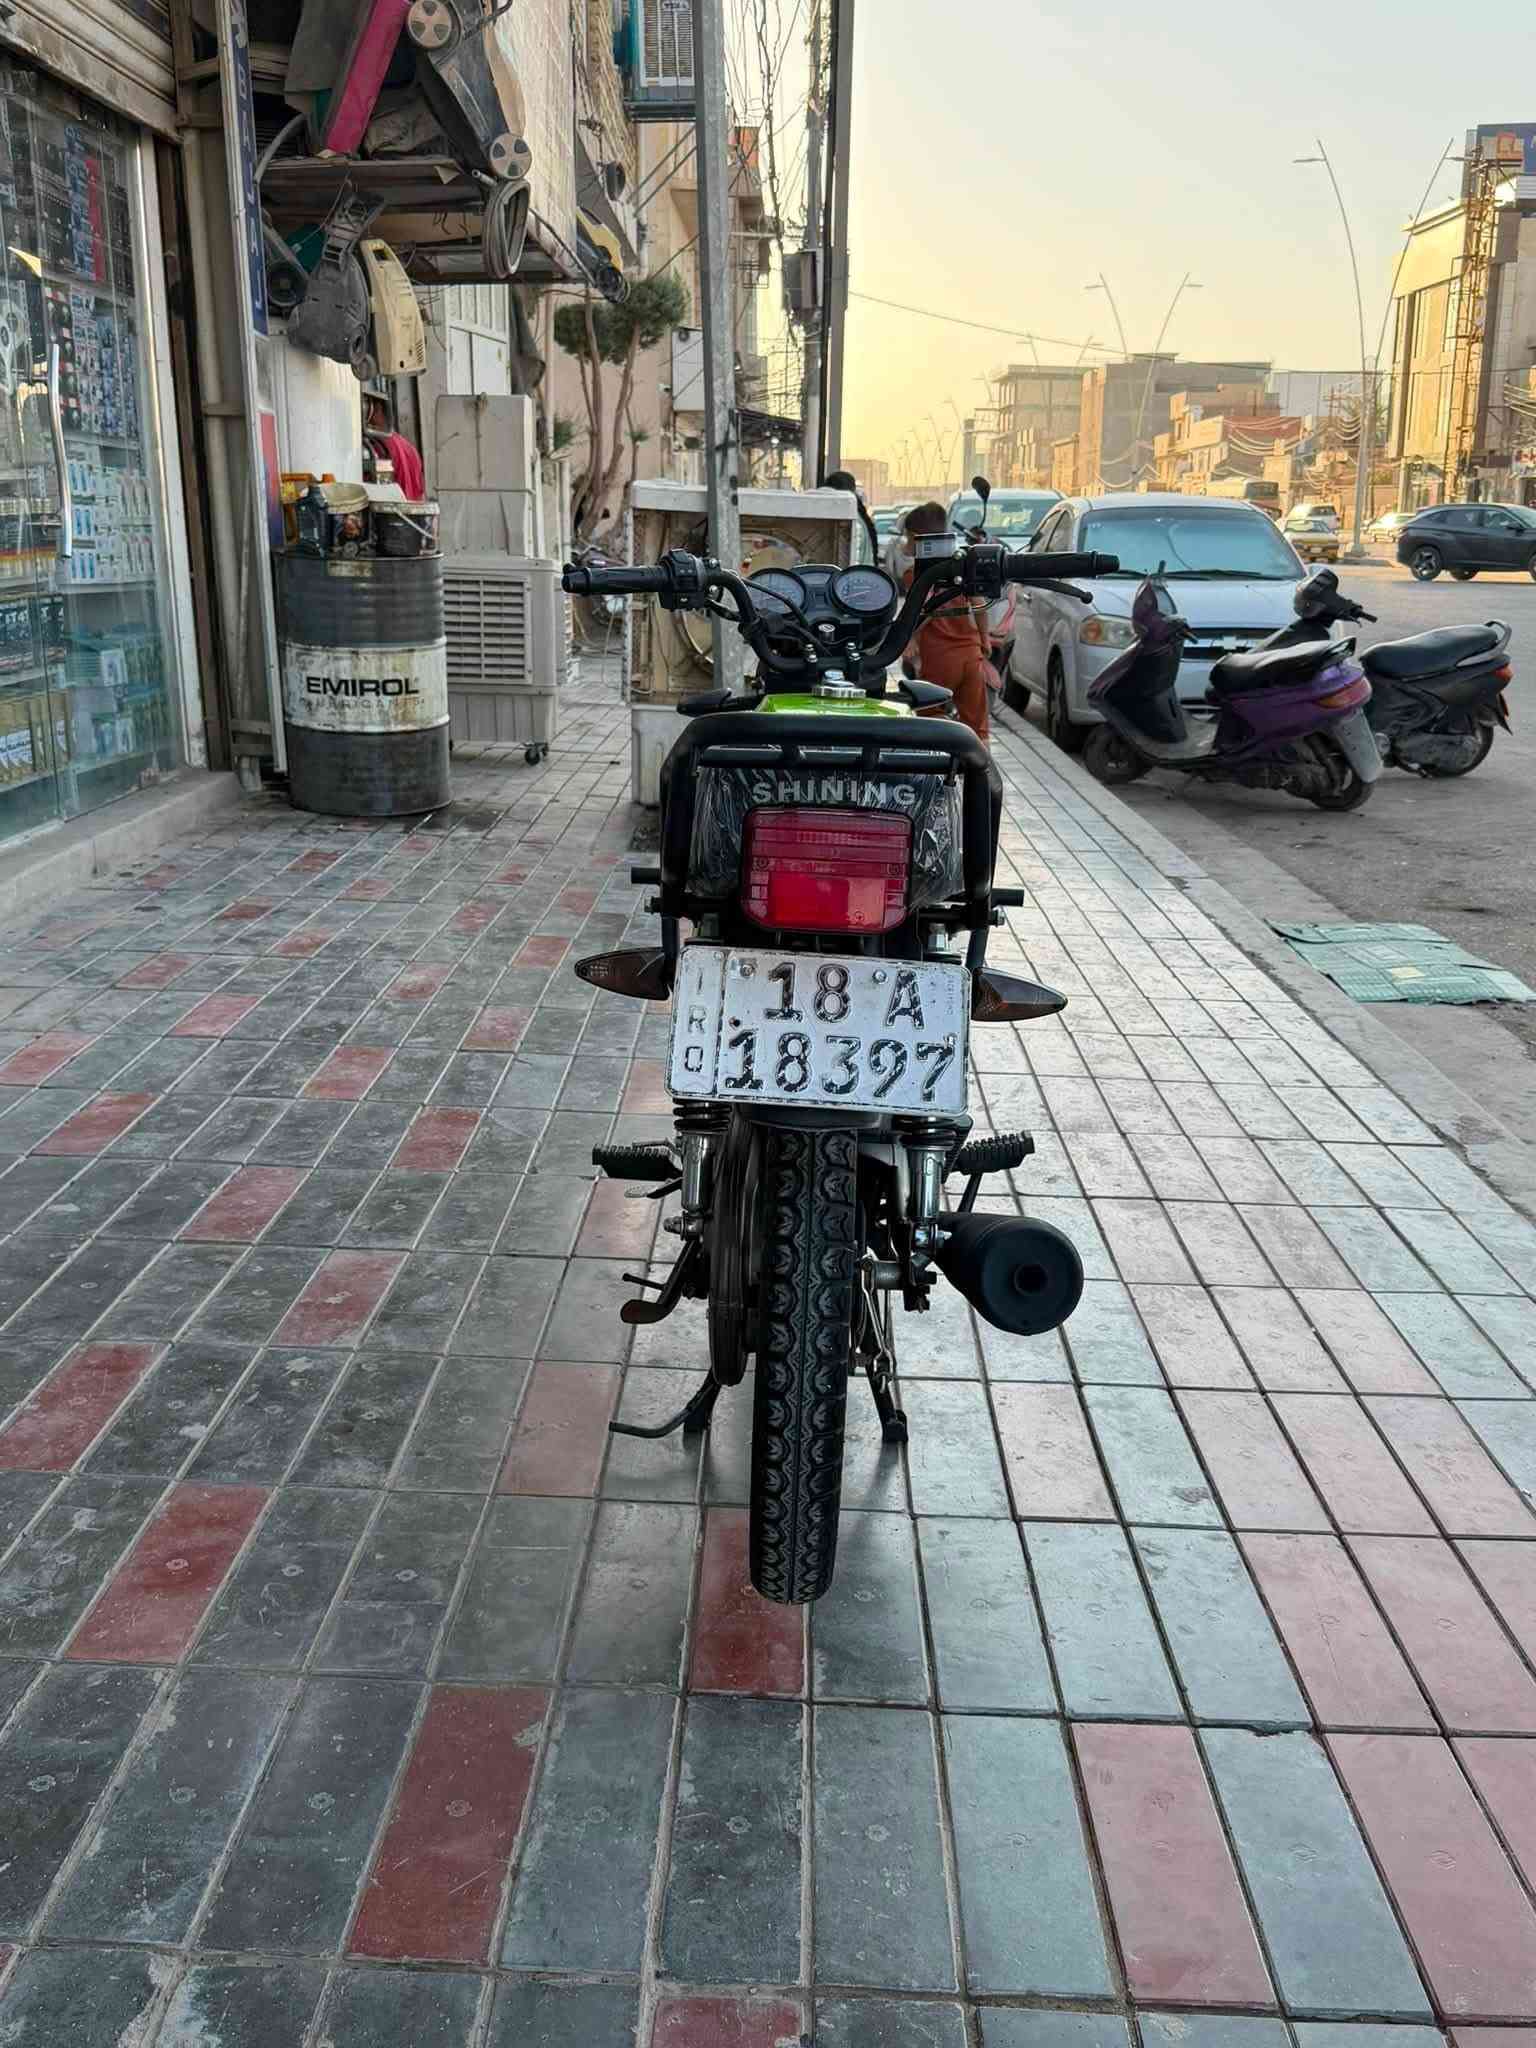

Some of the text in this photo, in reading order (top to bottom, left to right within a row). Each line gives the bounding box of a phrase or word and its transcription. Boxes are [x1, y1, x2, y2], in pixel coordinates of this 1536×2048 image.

[306, 677, 419, 696] EMIROL
[752, 779, 916, 806] SHINING
[764, 961, 851, 1023] 18
[885, 969, 924, 1030] A
[725, 1027, 956, 1101] 18397
